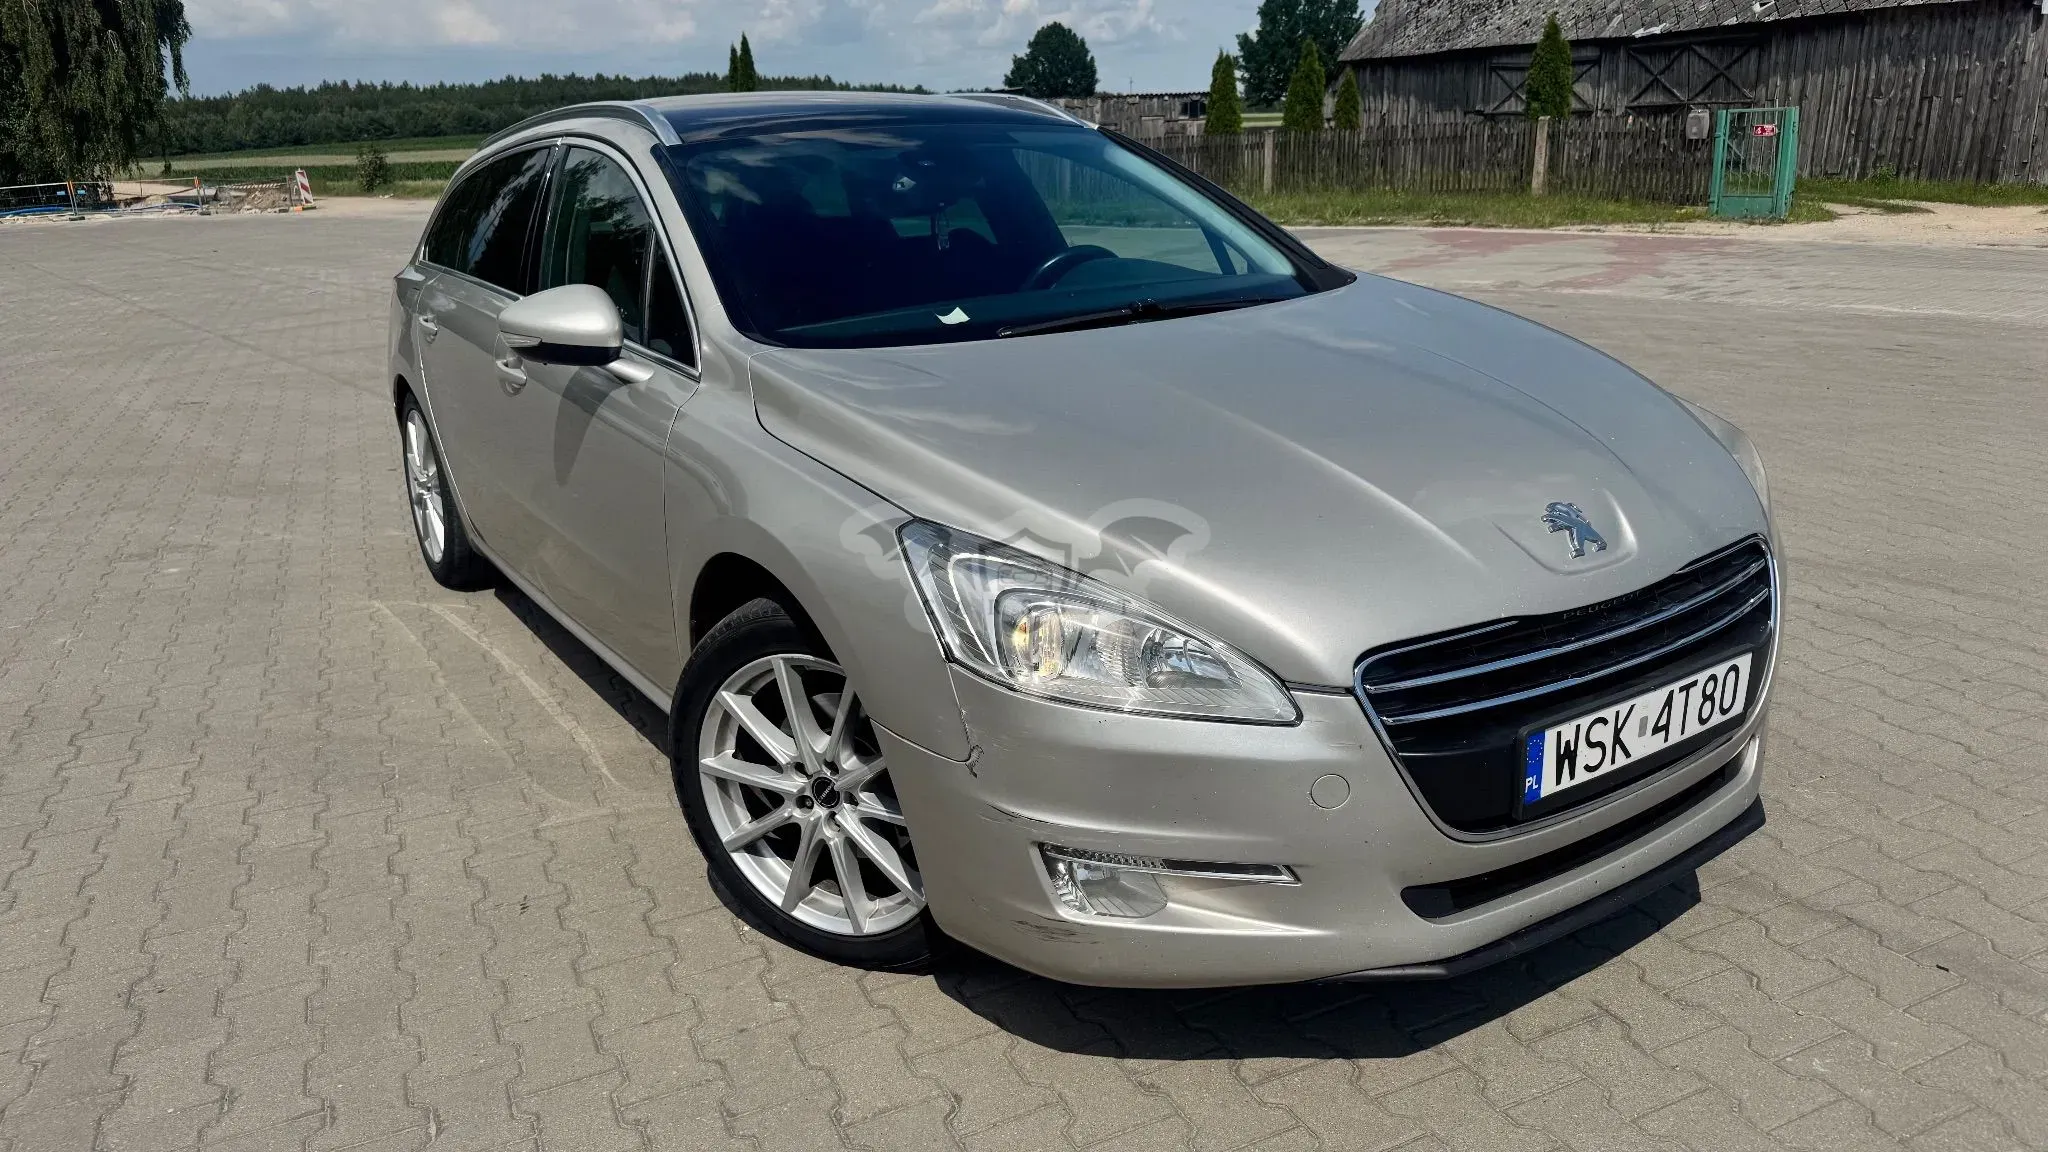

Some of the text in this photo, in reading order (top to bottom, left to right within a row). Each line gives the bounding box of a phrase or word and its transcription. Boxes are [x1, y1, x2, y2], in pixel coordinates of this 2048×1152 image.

[1555, 664, 1740, 786] WSK 4T80
[1525, 775, 1538, 793] PL
